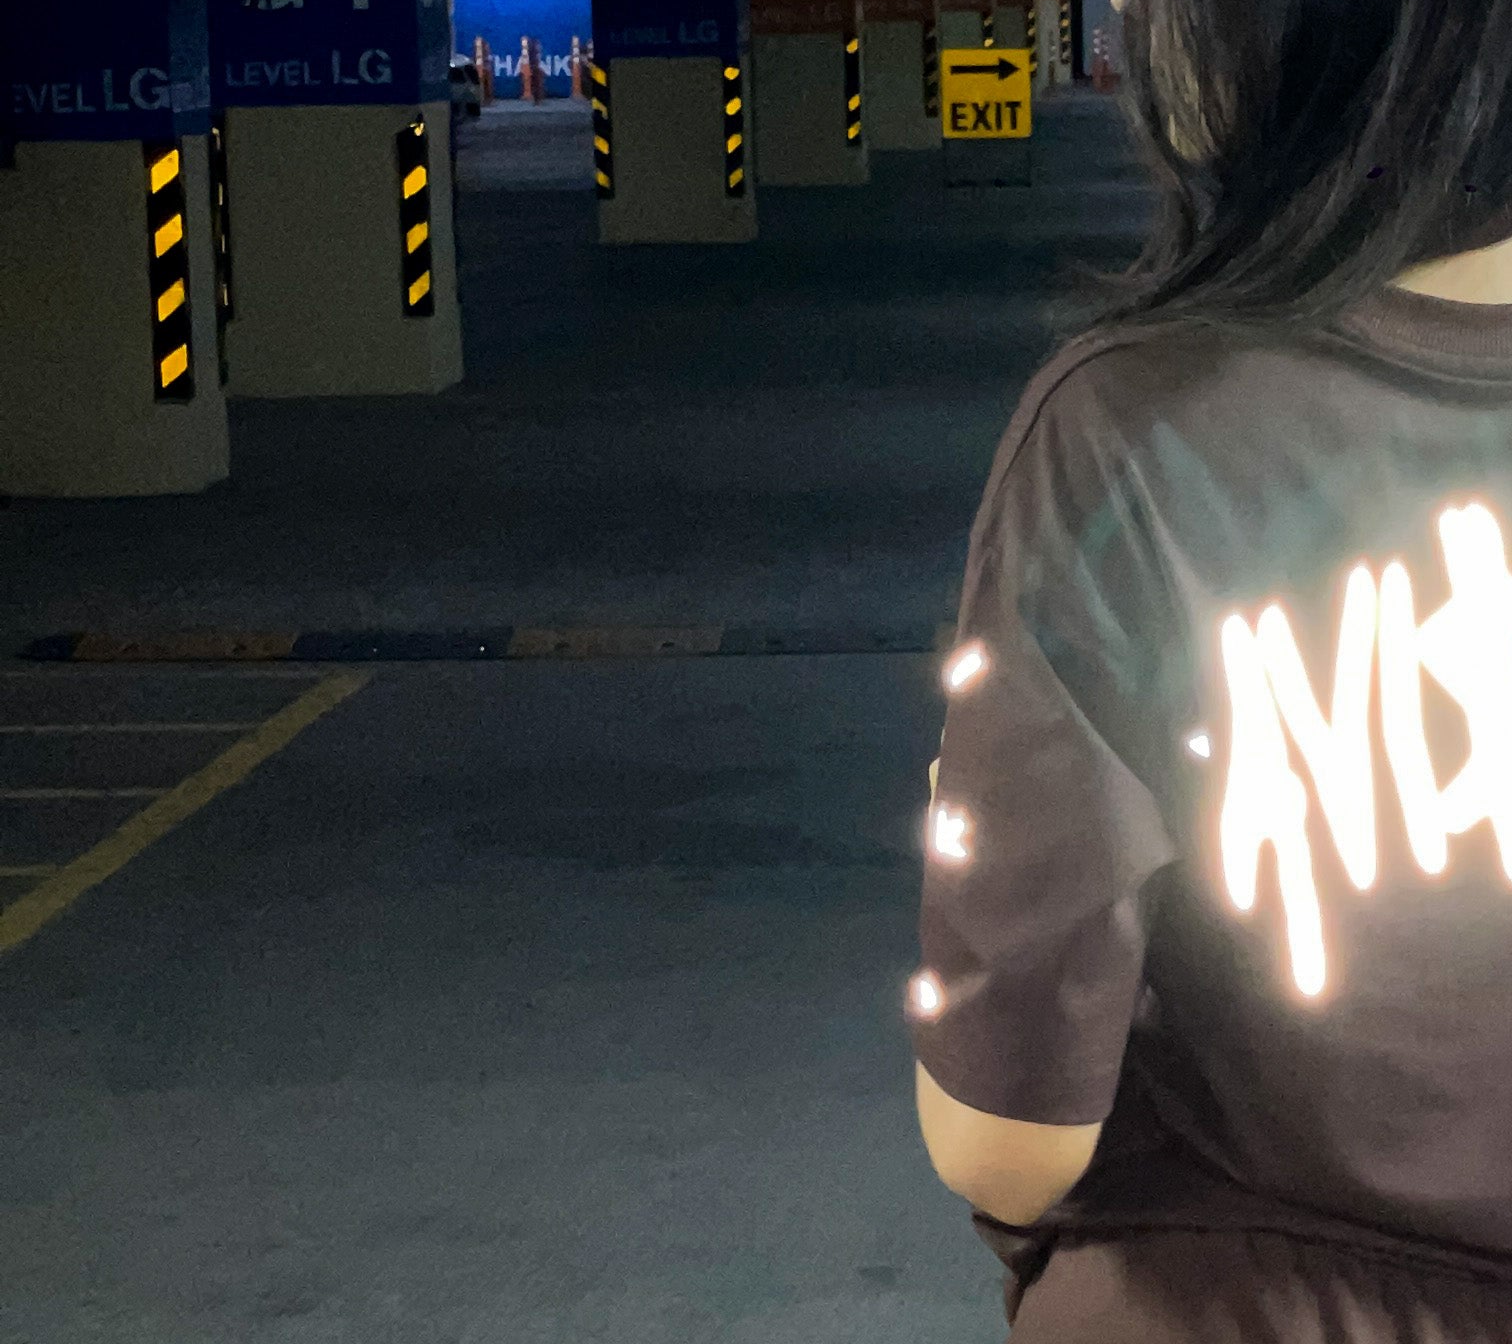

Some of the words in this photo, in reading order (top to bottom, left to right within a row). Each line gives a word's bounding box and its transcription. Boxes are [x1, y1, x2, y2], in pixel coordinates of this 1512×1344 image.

[677, 18, 721, 45] LG
[224, 60, 322, 88] LEVEL
[331, 48, 394, 86] LG
[101, 66, 171, 112] LG
[951, 101, 1021, 132] EXIT
